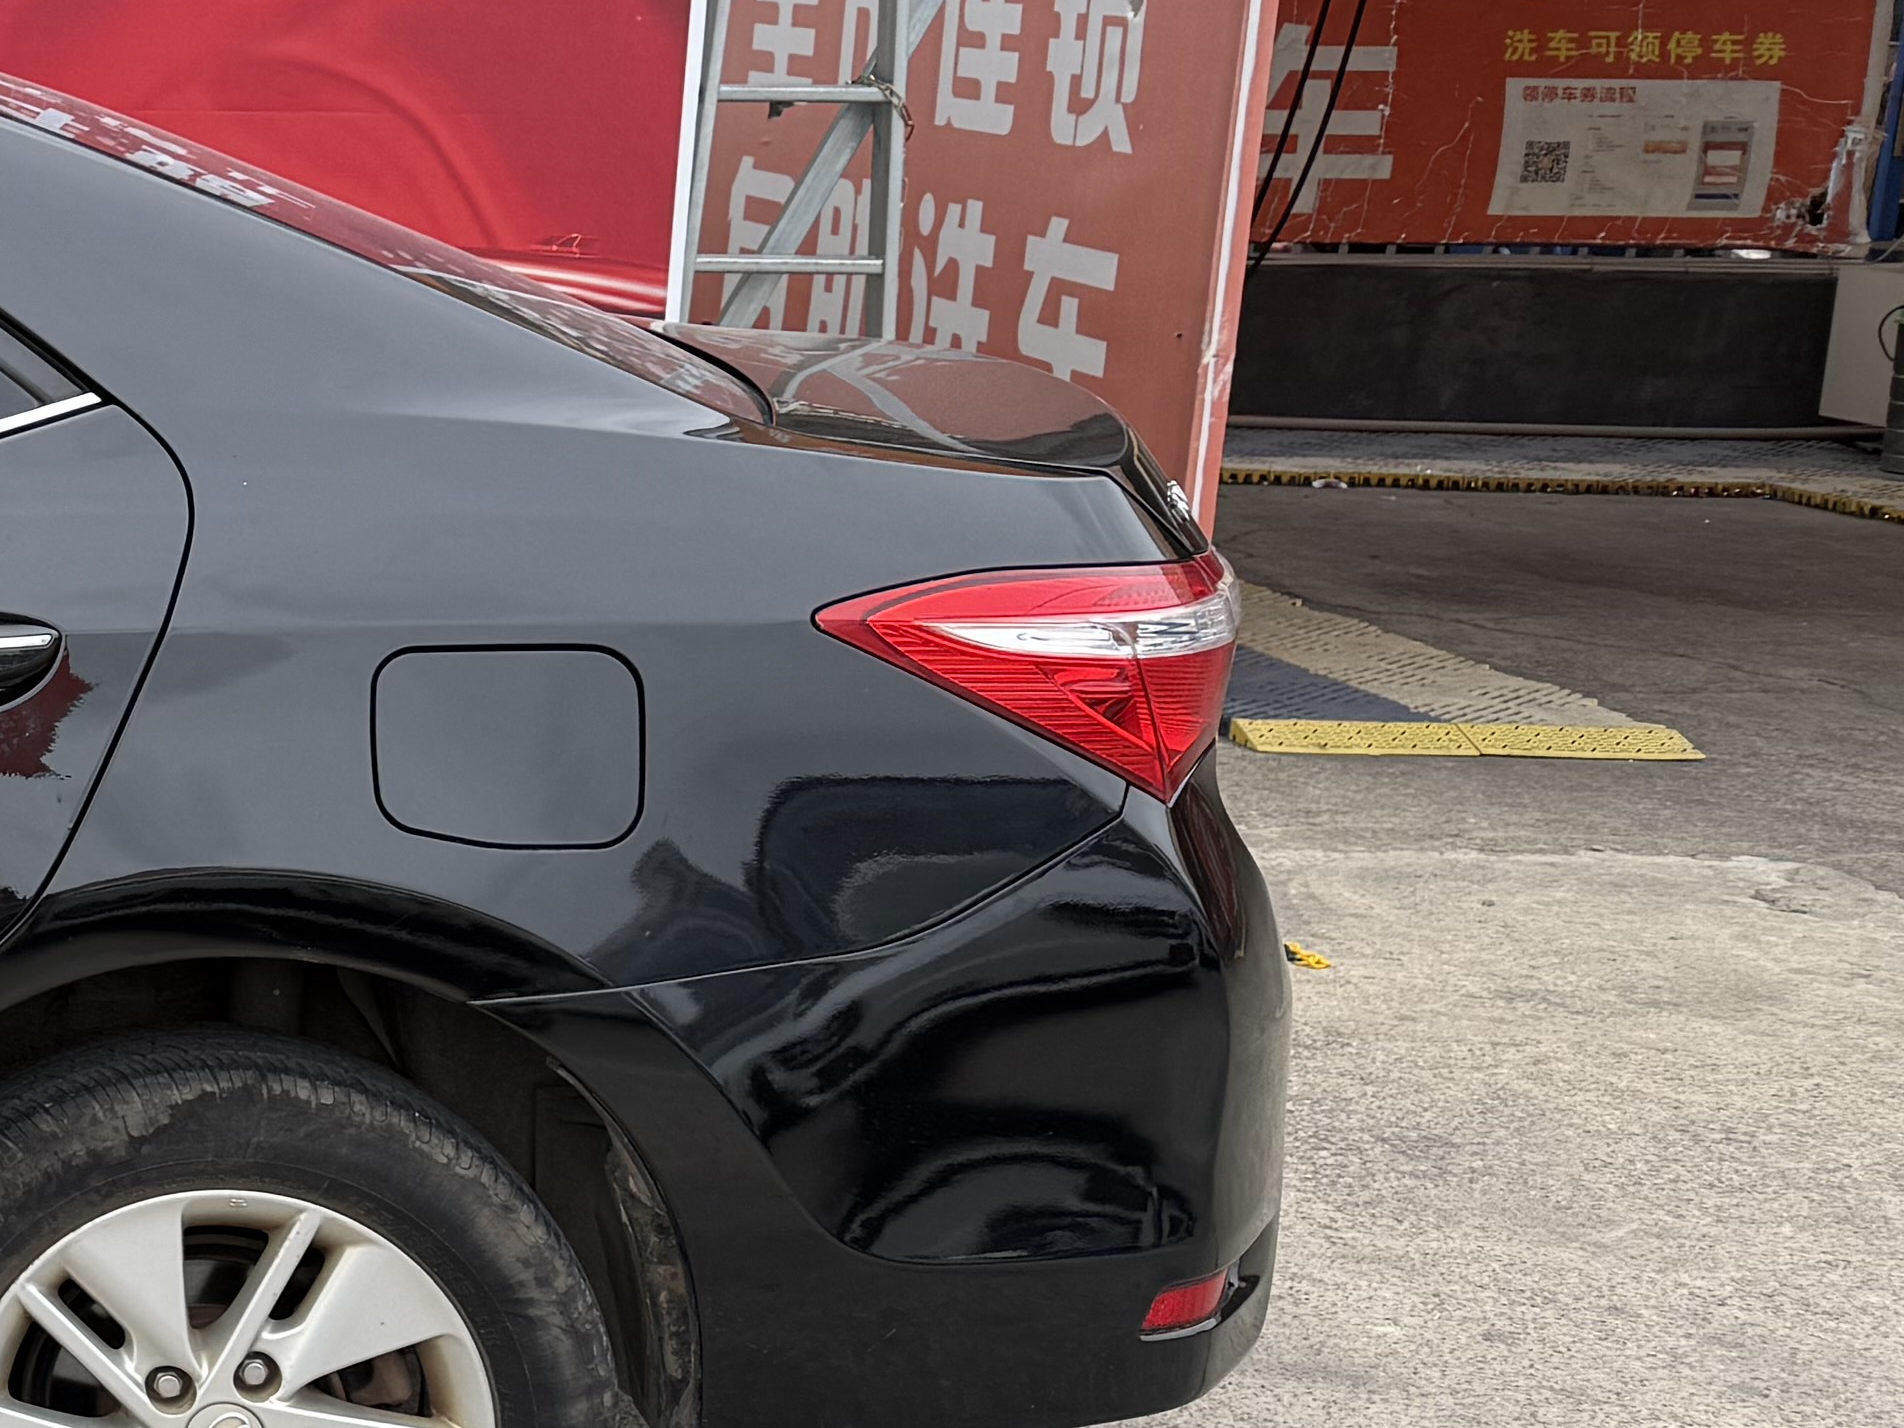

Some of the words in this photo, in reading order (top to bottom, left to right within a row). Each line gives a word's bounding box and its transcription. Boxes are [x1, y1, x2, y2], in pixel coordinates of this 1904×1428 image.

[1503, 28, 1787, 65] 洗车可领停车券
